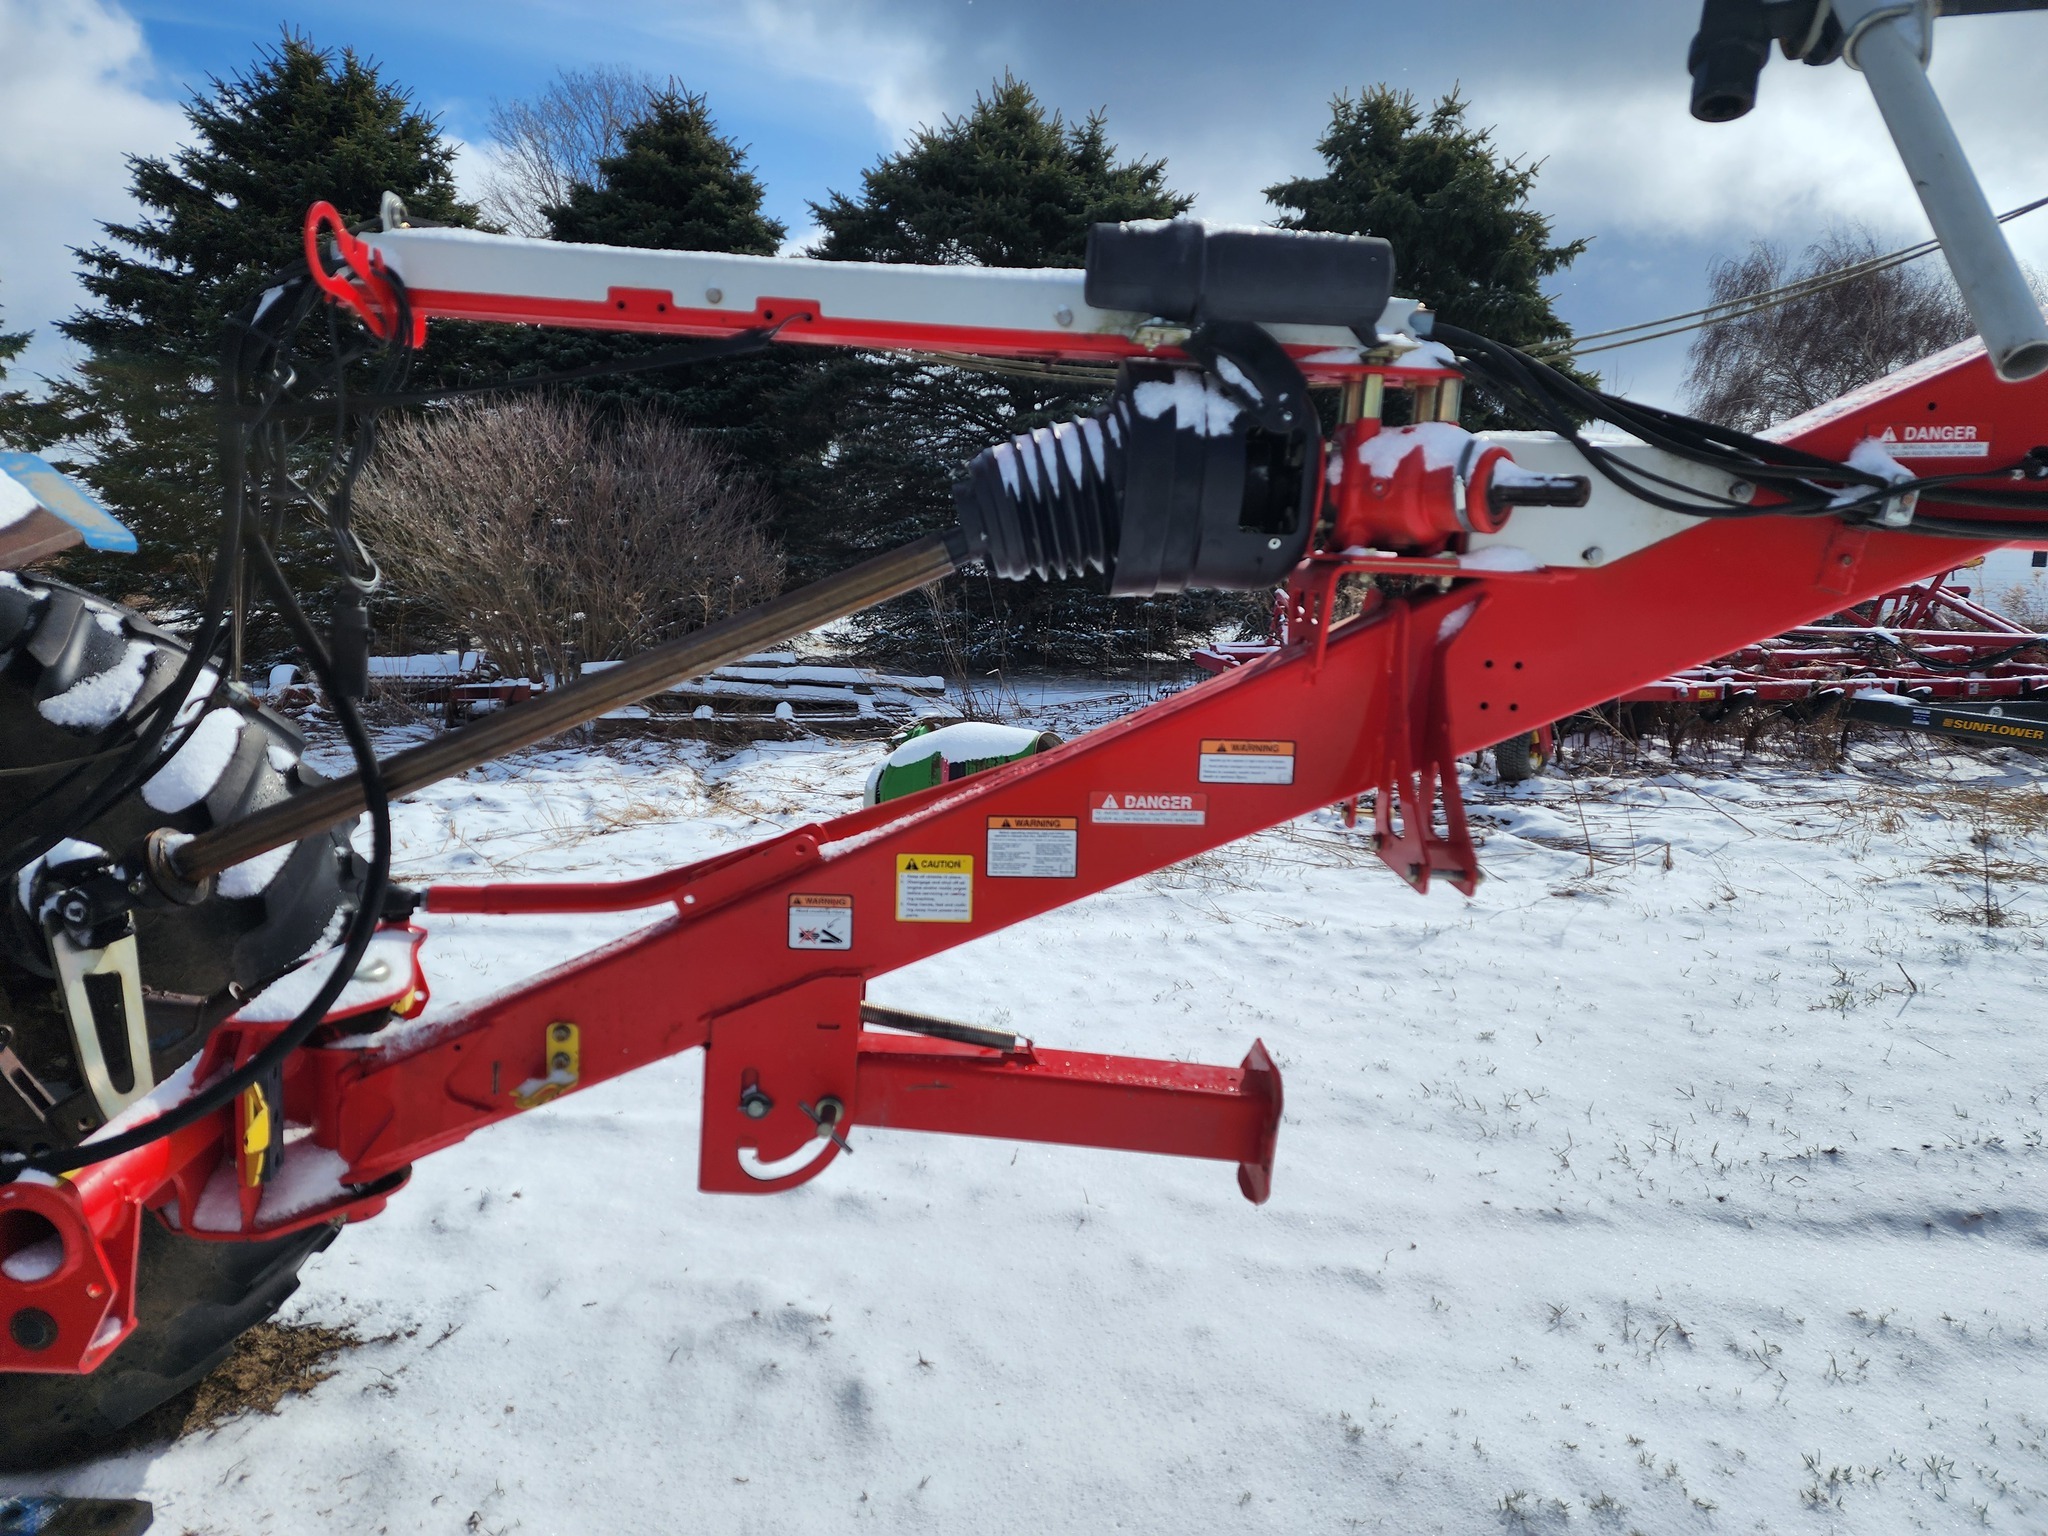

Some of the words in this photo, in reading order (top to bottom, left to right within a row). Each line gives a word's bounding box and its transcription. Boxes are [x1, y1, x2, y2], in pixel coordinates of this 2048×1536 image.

[1904, 426, 1977, 440] DANGER
[1953, 719, 2045, 740] SUNFLOWER
[1231, 744, 1280, 753] WARNING
[1124, 795, 1192, 809] DANGER
[1014, 819, 1061, 828] WARNING
[921, 860, 961, 869] CAUTION
[805, 897, 846, 905] WARNING
